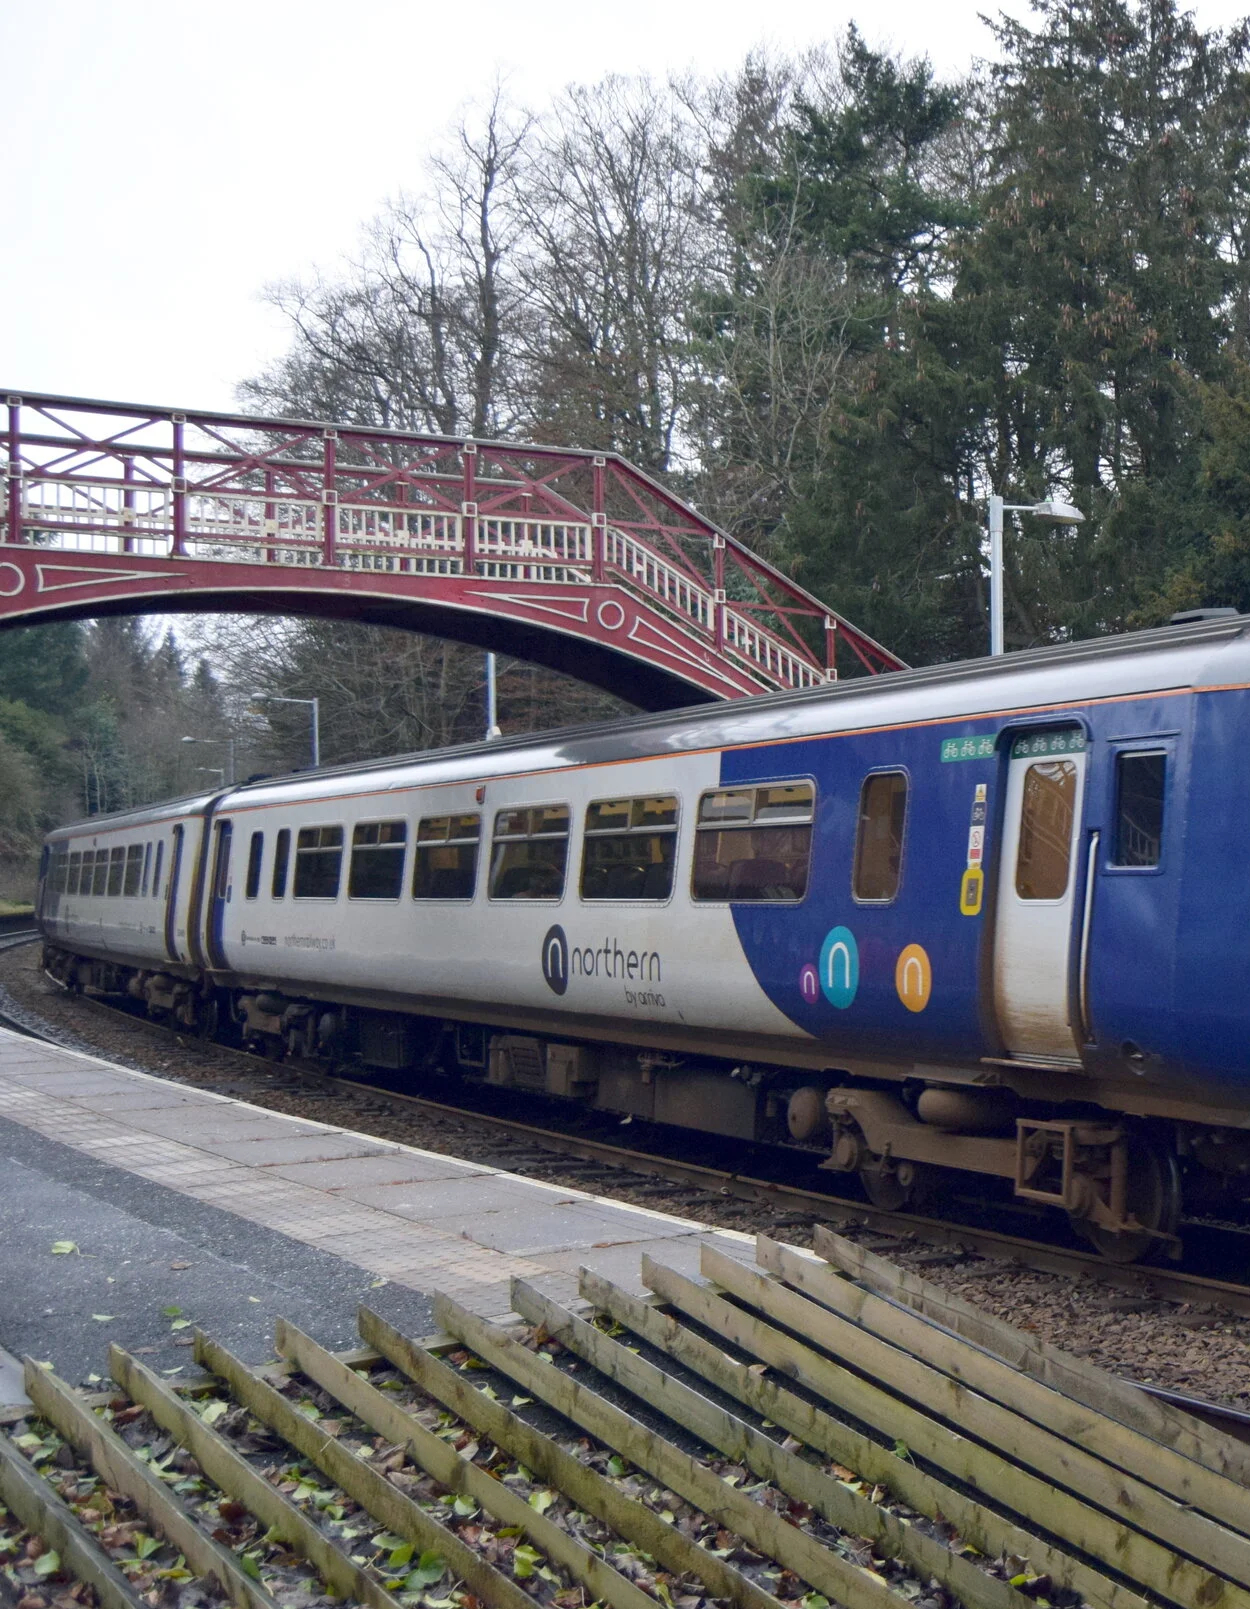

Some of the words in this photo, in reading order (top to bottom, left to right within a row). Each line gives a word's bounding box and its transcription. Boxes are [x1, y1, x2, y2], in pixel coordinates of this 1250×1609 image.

[571, 936, 662, 982] northern
[624, 985, 638, 1008] by
[638, 989, 666, 1008] arriva
